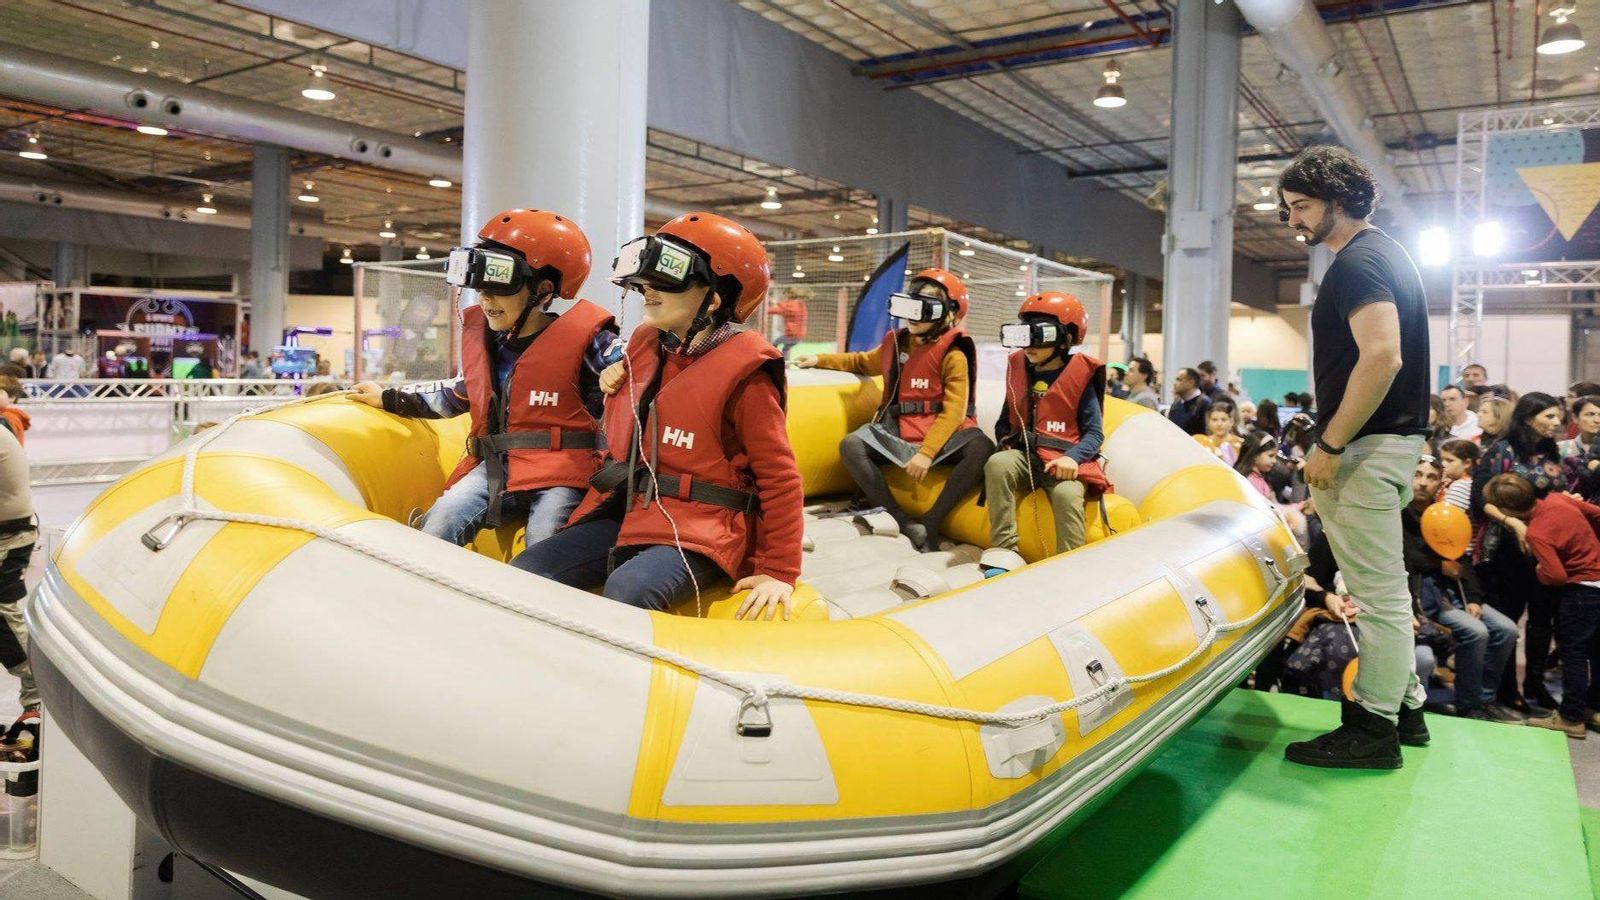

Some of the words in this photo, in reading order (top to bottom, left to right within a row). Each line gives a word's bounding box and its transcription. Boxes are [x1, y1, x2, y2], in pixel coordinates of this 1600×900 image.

[911, 378, 929, 389] HH
[529, 390, 559, 406] HH
[1046, 421, 1066, 432] HH
[662, 425, 695, 449] HH
